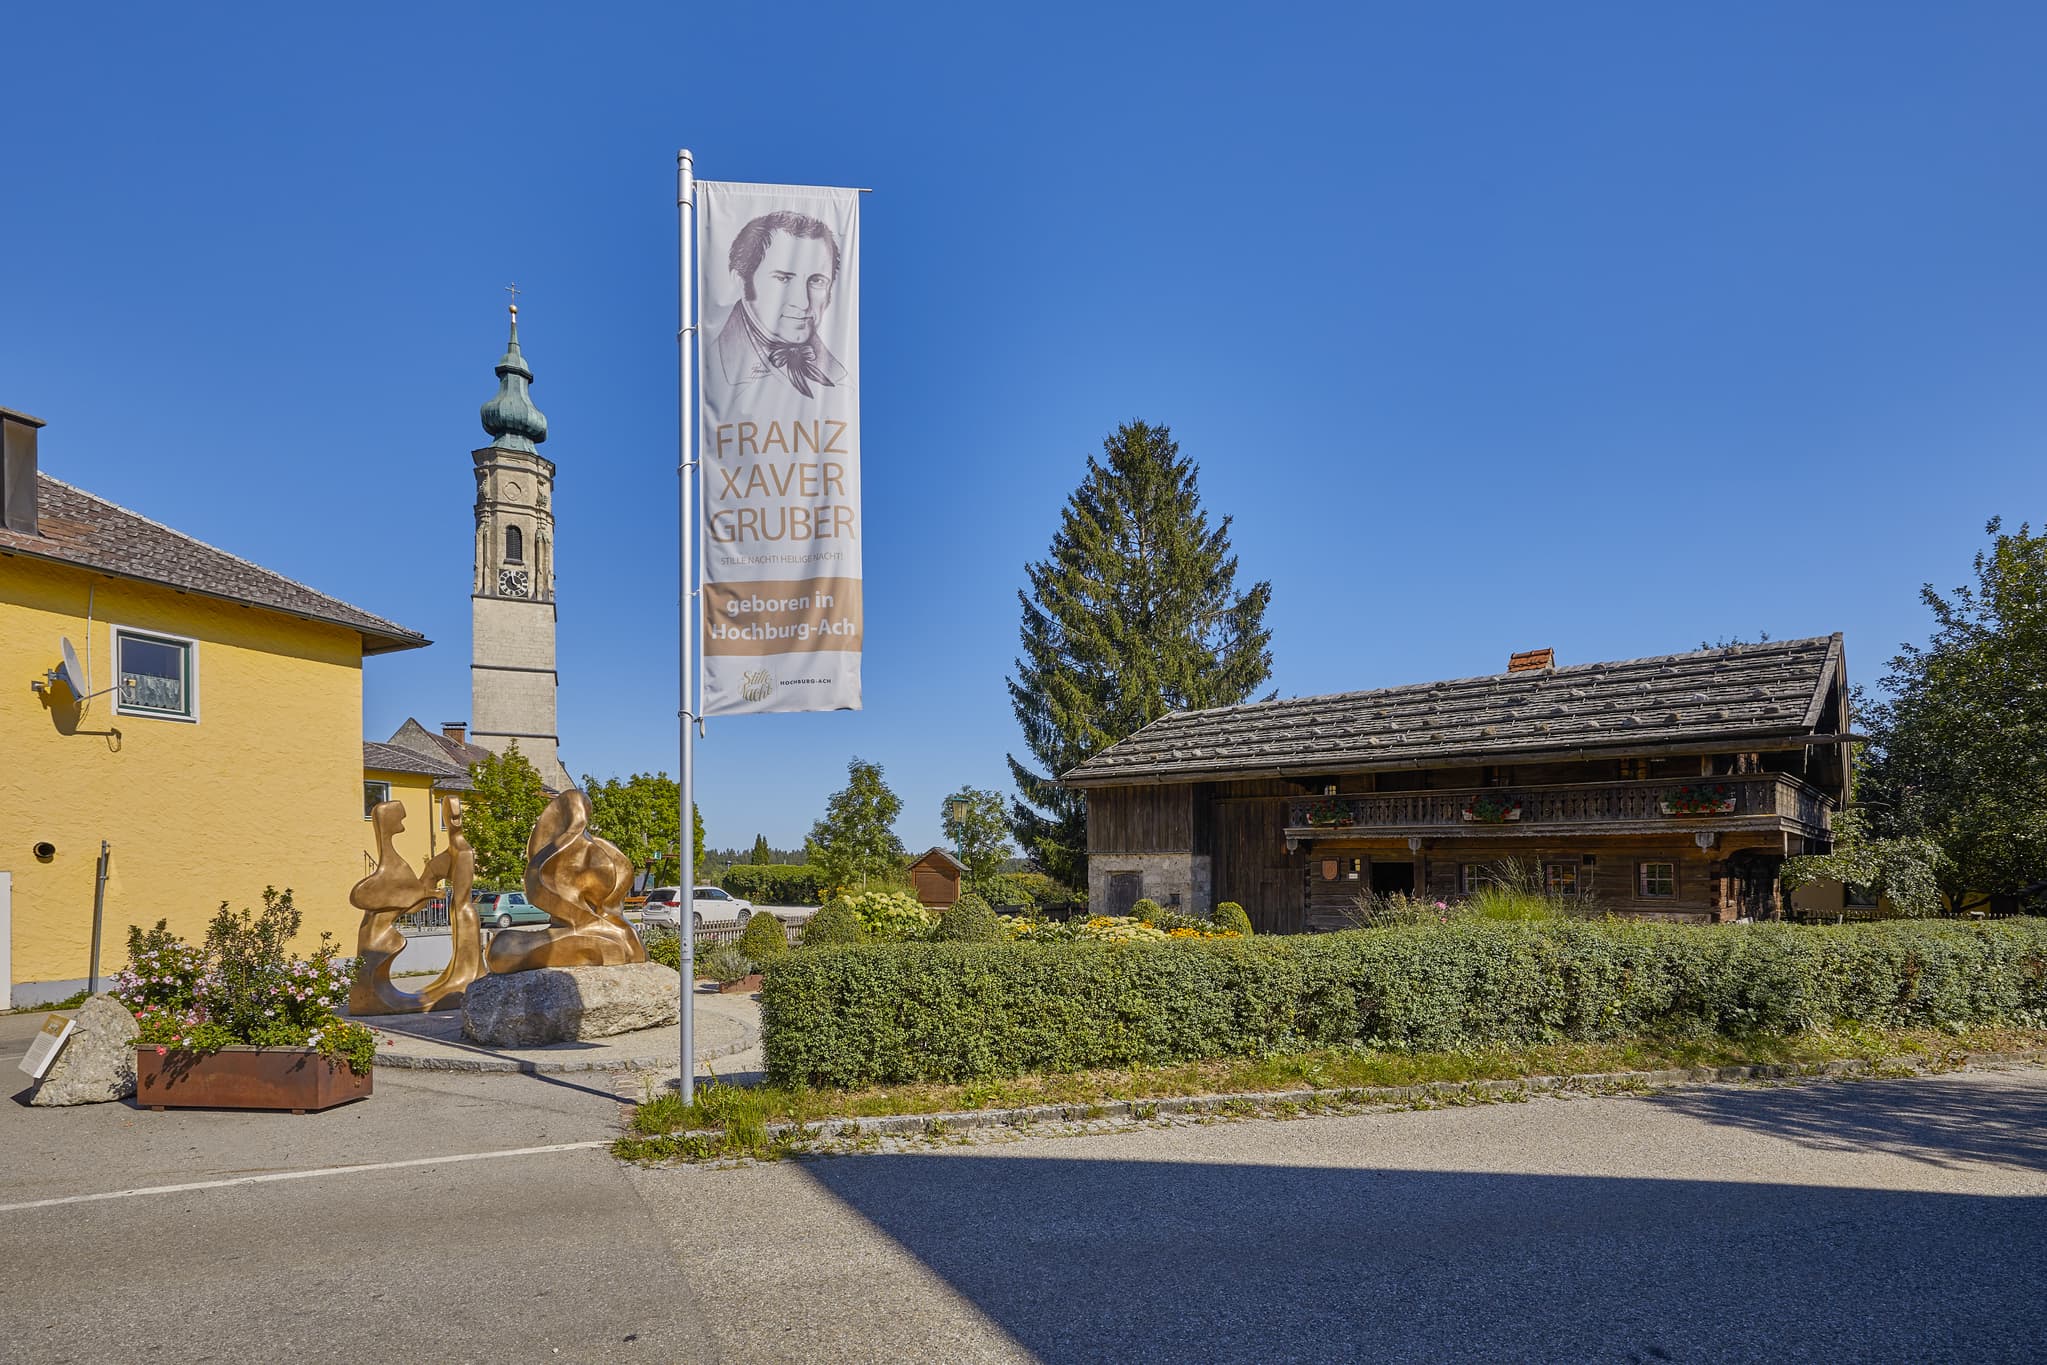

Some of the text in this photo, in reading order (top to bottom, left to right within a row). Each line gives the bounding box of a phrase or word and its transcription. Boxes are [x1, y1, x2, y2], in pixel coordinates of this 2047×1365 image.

[716, 420, 848, 459] FRANZ
[720, 462, 845, 500] XAVER
[710, 505, 855, 543] GRUBER
[726, 591, 834, 618] geboren in
[711, 617, 856, 641] Hochburg-Ach
